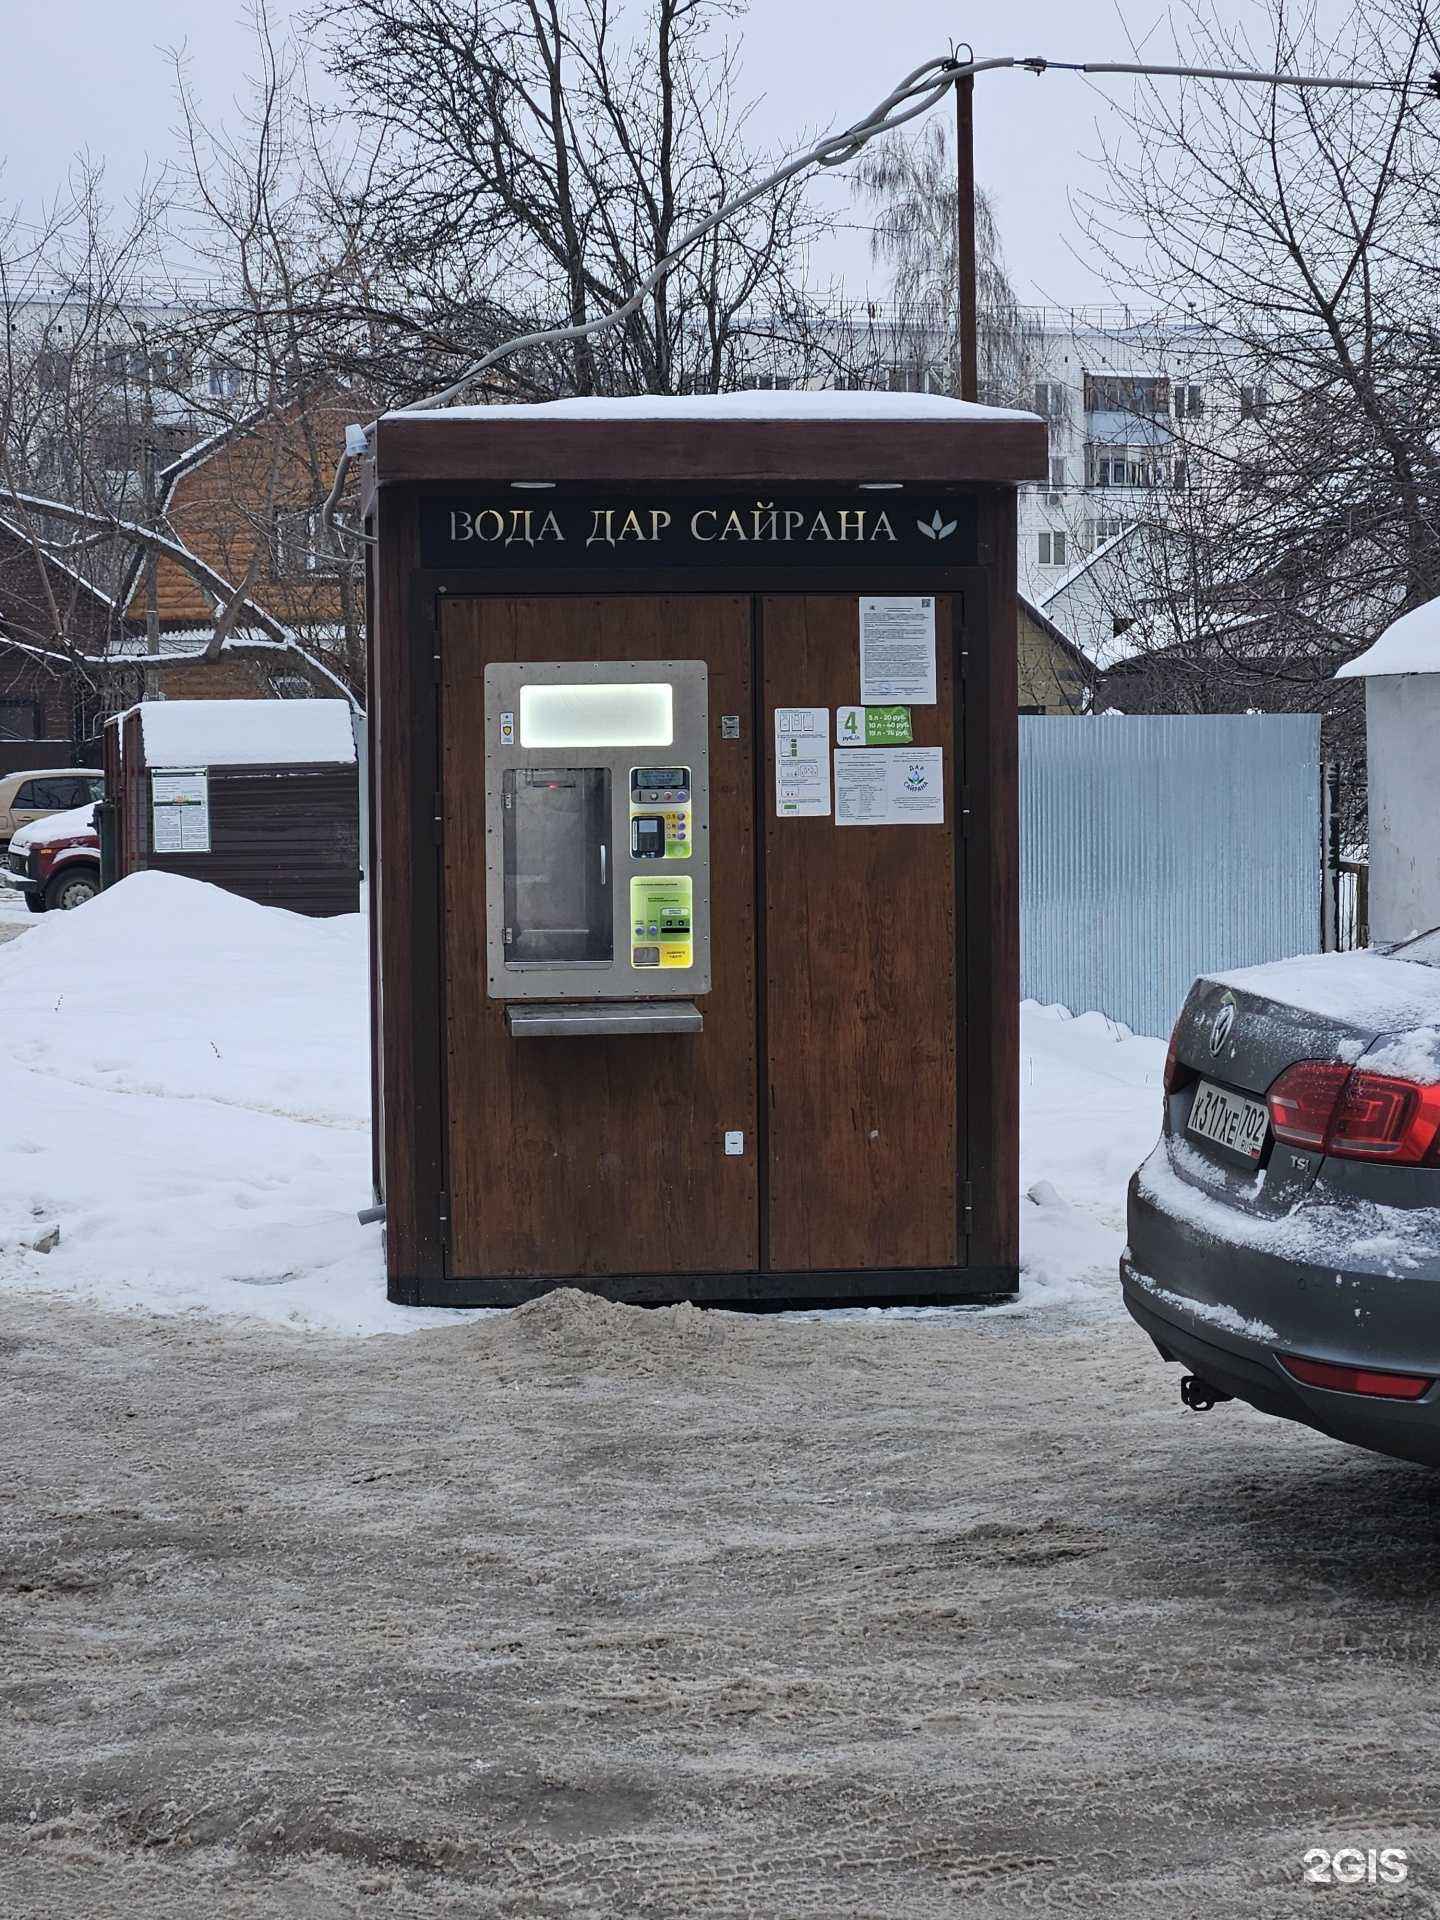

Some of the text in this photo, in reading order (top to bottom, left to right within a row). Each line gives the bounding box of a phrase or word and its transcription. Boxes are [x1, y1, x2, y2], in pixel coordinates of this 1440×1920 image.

[449, 501, 898, 549] ВОДА ДАР САЙРАНА
[844, 711, 858, 734] 4
